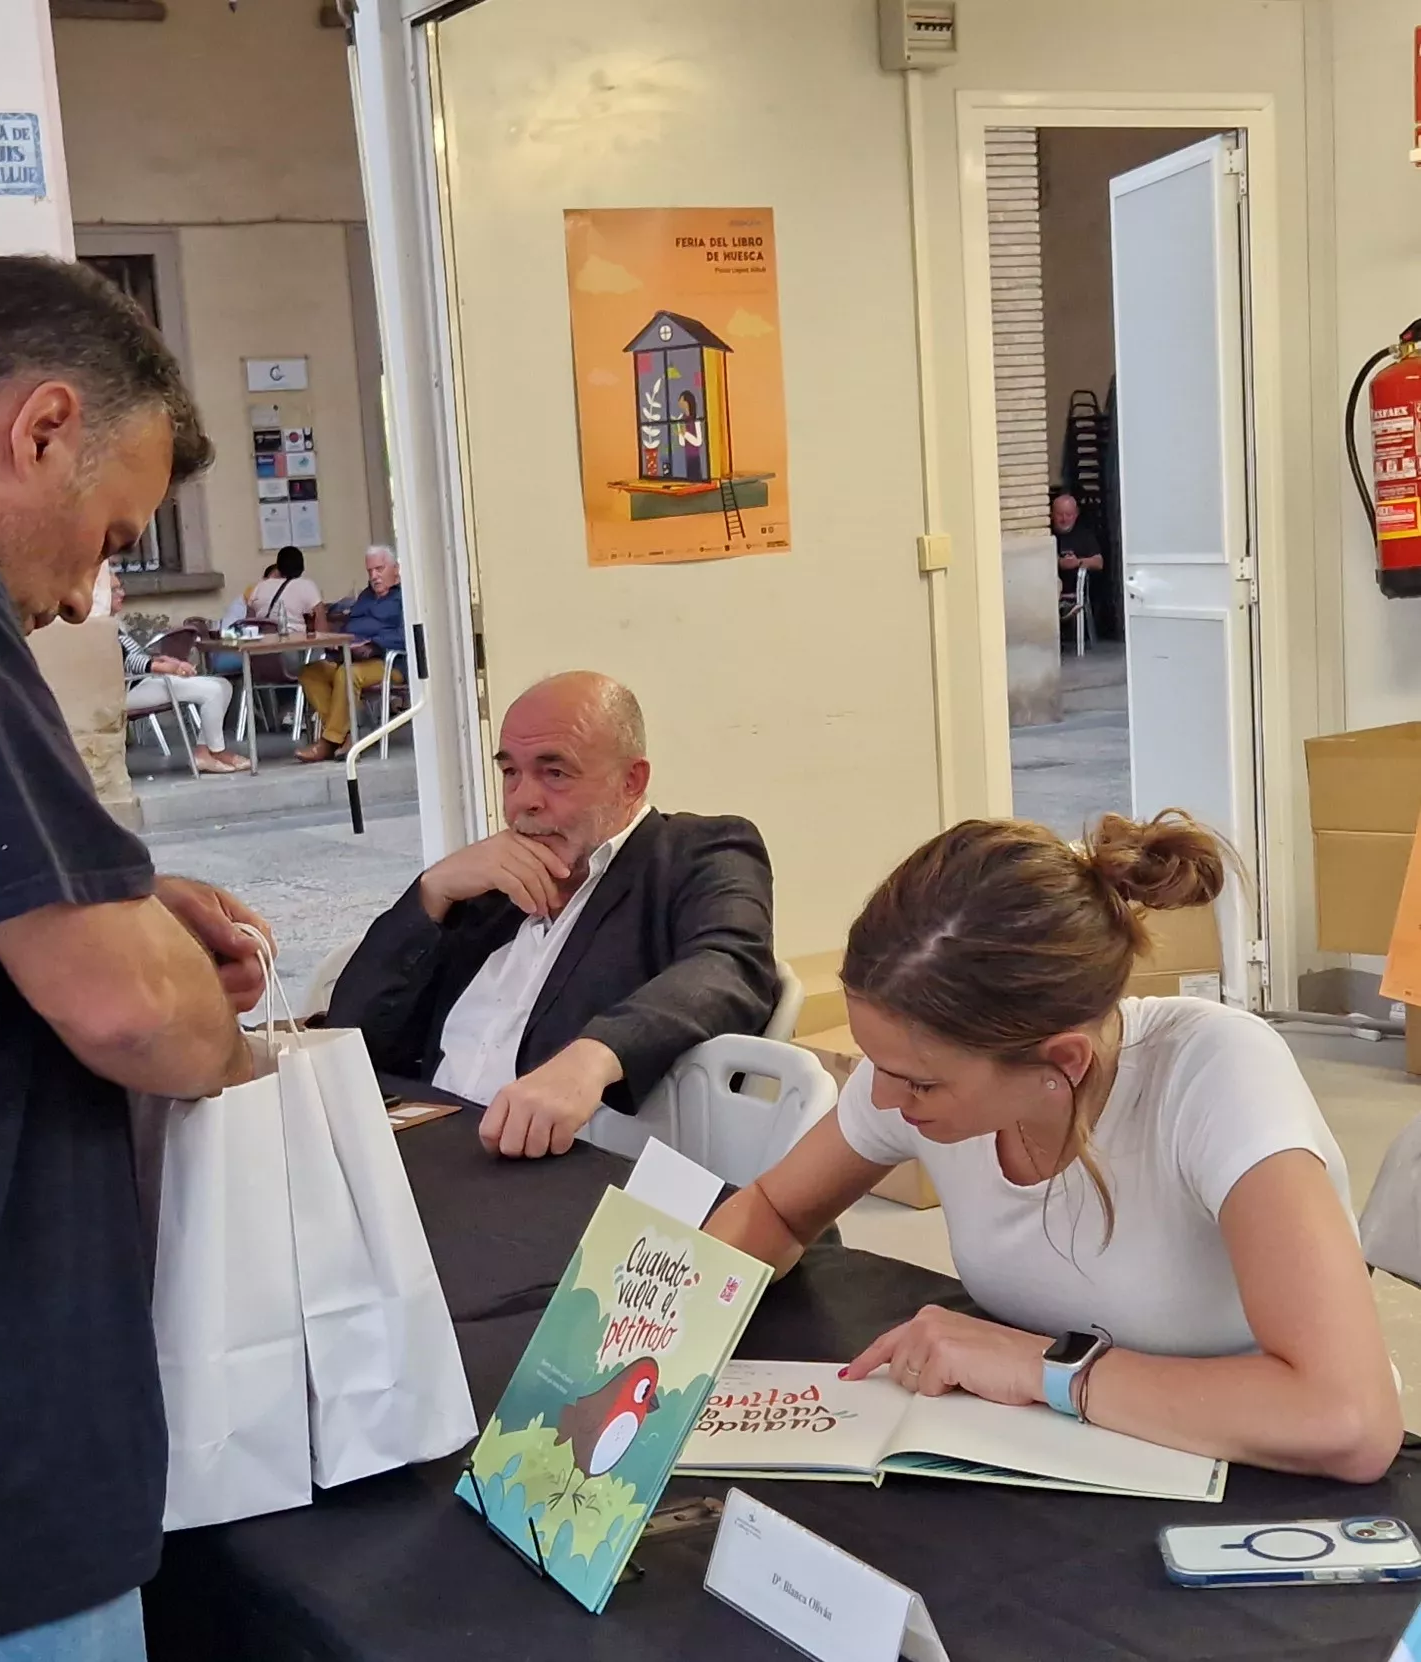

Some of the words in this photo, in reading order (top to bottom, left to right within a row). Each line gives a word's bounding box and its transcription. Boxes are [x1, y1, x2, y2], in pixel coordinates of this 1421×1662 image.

[12, 127, 31, 141] DE
[675, 237, 705, 248] FERIA
[710, 237, 728, 248] DEL
[732, 236, 763, 247] LIBRO
[706, 251, 719, 262] DE
[723, 250, 764, 262] HUESCA
[626, 1236, 690, 1288] Cuando
[618, 1279, 659, 1312] vuela
[661, 1288, 678, 1320] el
[600, 1311, 678, 1360] petirrojo
[706, 1385, 820, 1408] petirro
[699, 1408, 720, 1421] el
[743, 1405, 830, 1421] vuela
[694, 1417, 837, 1437] Cuando
[783, 1580, 807, 1605] Blanca
